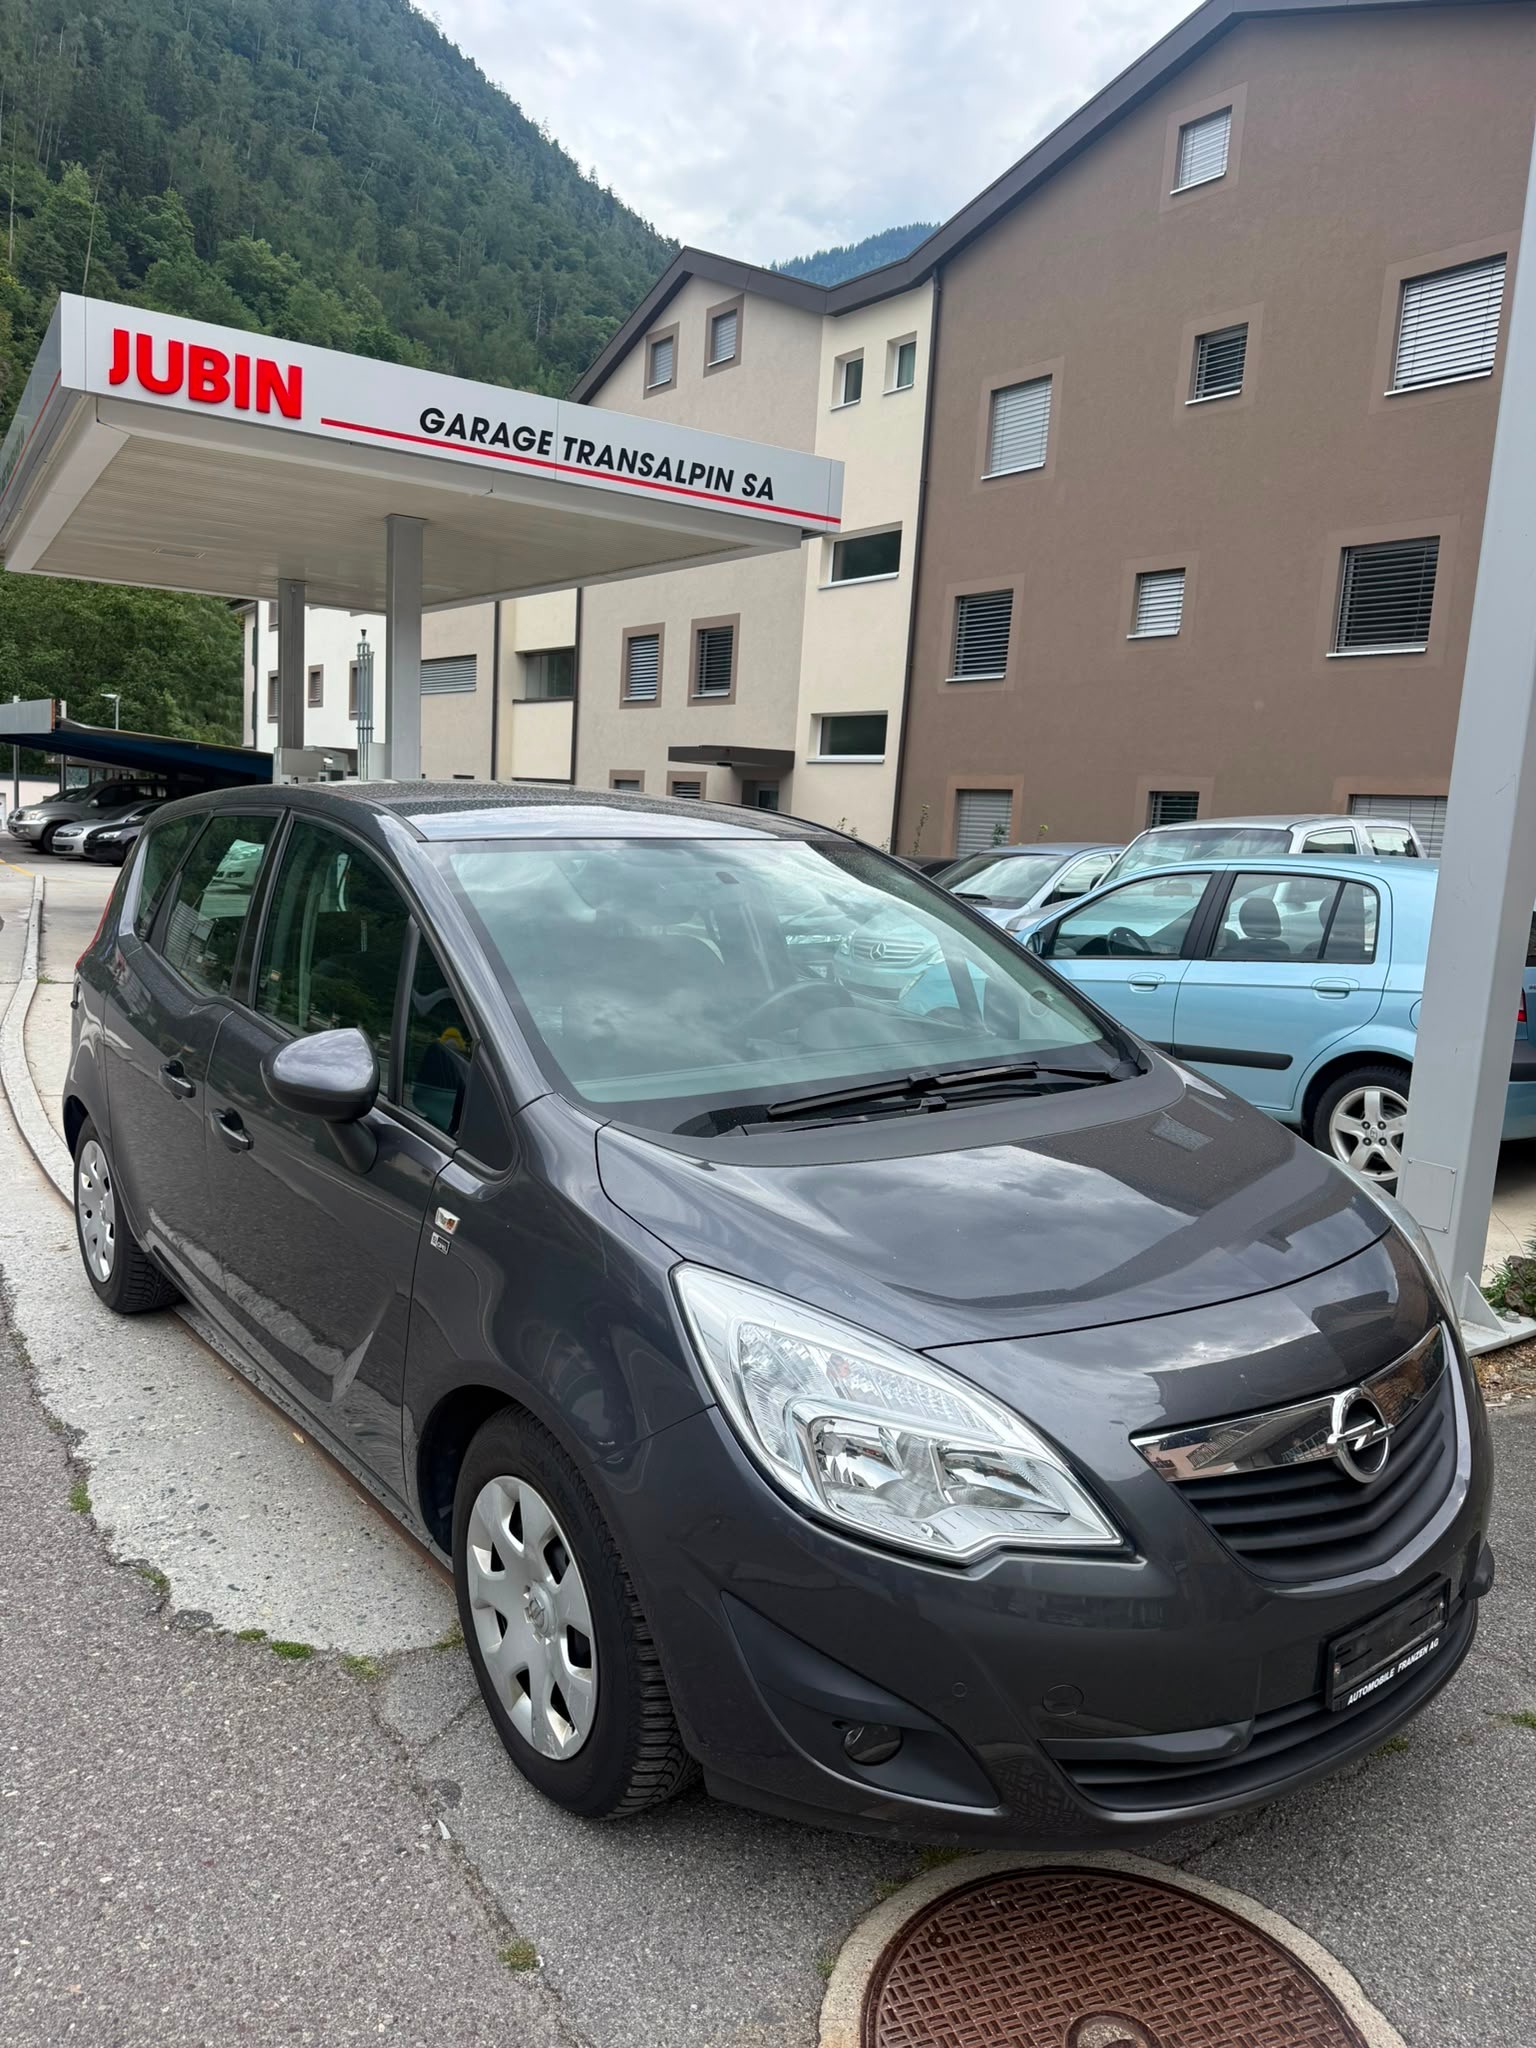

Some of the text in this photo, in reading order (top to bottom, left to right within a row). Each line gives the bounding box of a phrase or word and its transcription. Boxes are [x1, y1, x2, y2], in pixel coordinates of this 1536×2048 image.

[109, 328, 303, 420] JUBIN
[420, 407, 774, 501] GARAGE TRANSALPIN SA
[1347, 1637, 1440, 1706] AUTOMOBILE FRANZEN AG
